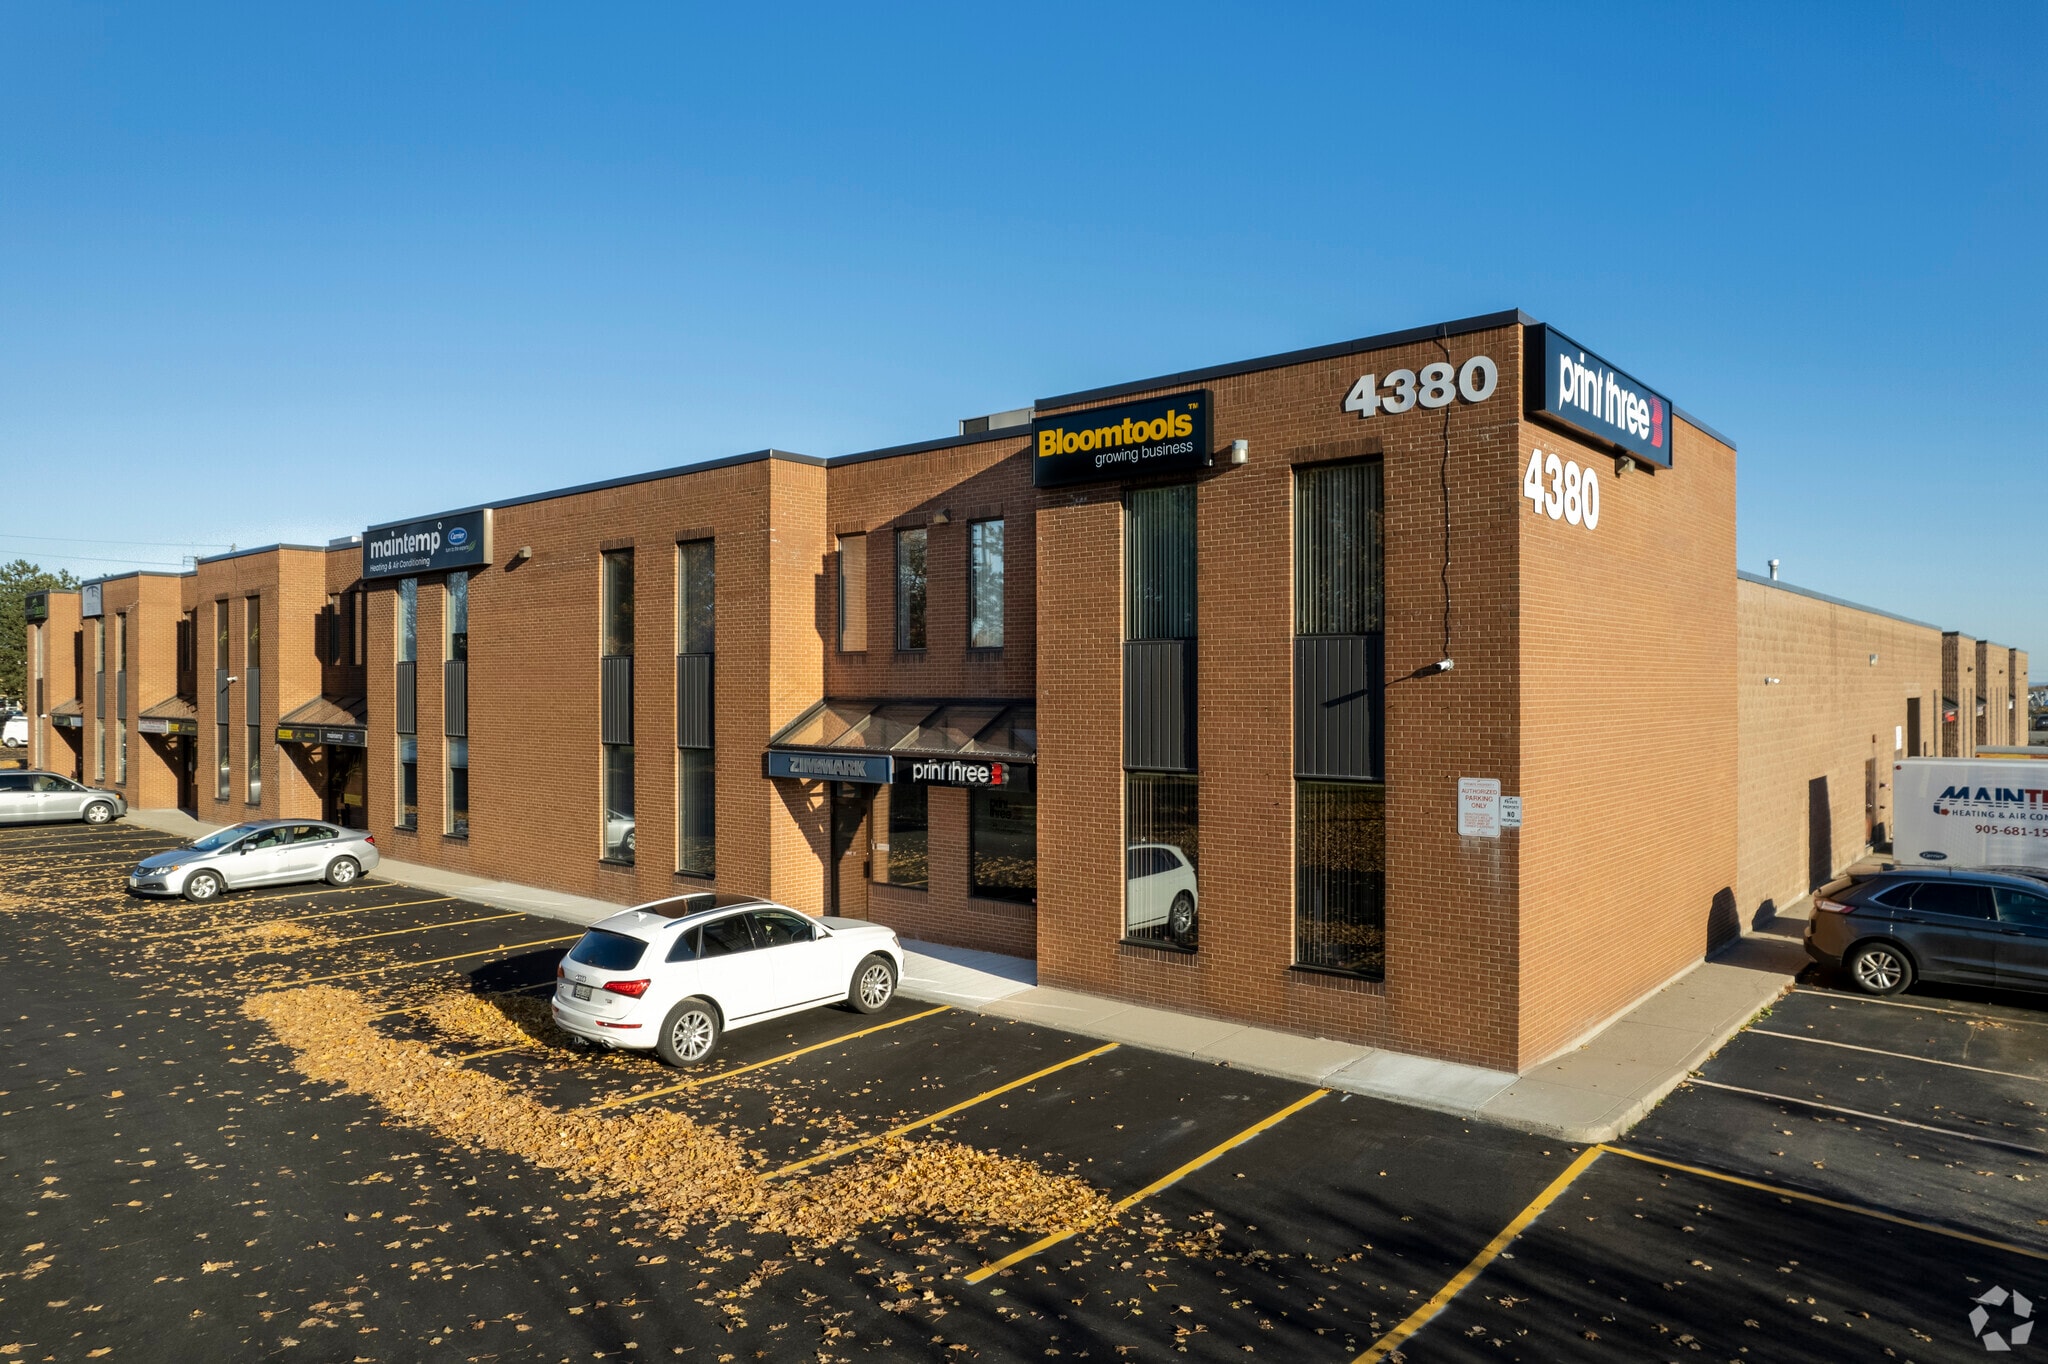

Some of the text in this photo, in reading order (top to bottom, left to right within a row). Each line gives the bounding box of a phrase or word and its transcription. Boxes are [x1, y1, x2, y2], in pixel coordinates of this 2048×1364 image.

[1345, 355, 1498, 417] 4380
[1559, 352, 1603, 418] print
[1605, 372, 1650, 440] three
[1038, 409, 1193, 457] Bloomtools
[1095, 441, 1194, 468] growing business
[1523, 448, 1600, 530] 4380
[370, 564, 388, 572] Heating
[388, 561, 392, 570] &
[400, 557, 431, 568] Conditioning
[789, 757, 867, 777] ZIMMARK
[913, 759, 946, 783] print
[948, 761, 990, 783] three
[1952, 810, 1995, 818] HEATING
[2009, 812, 2027, 820] AIR
